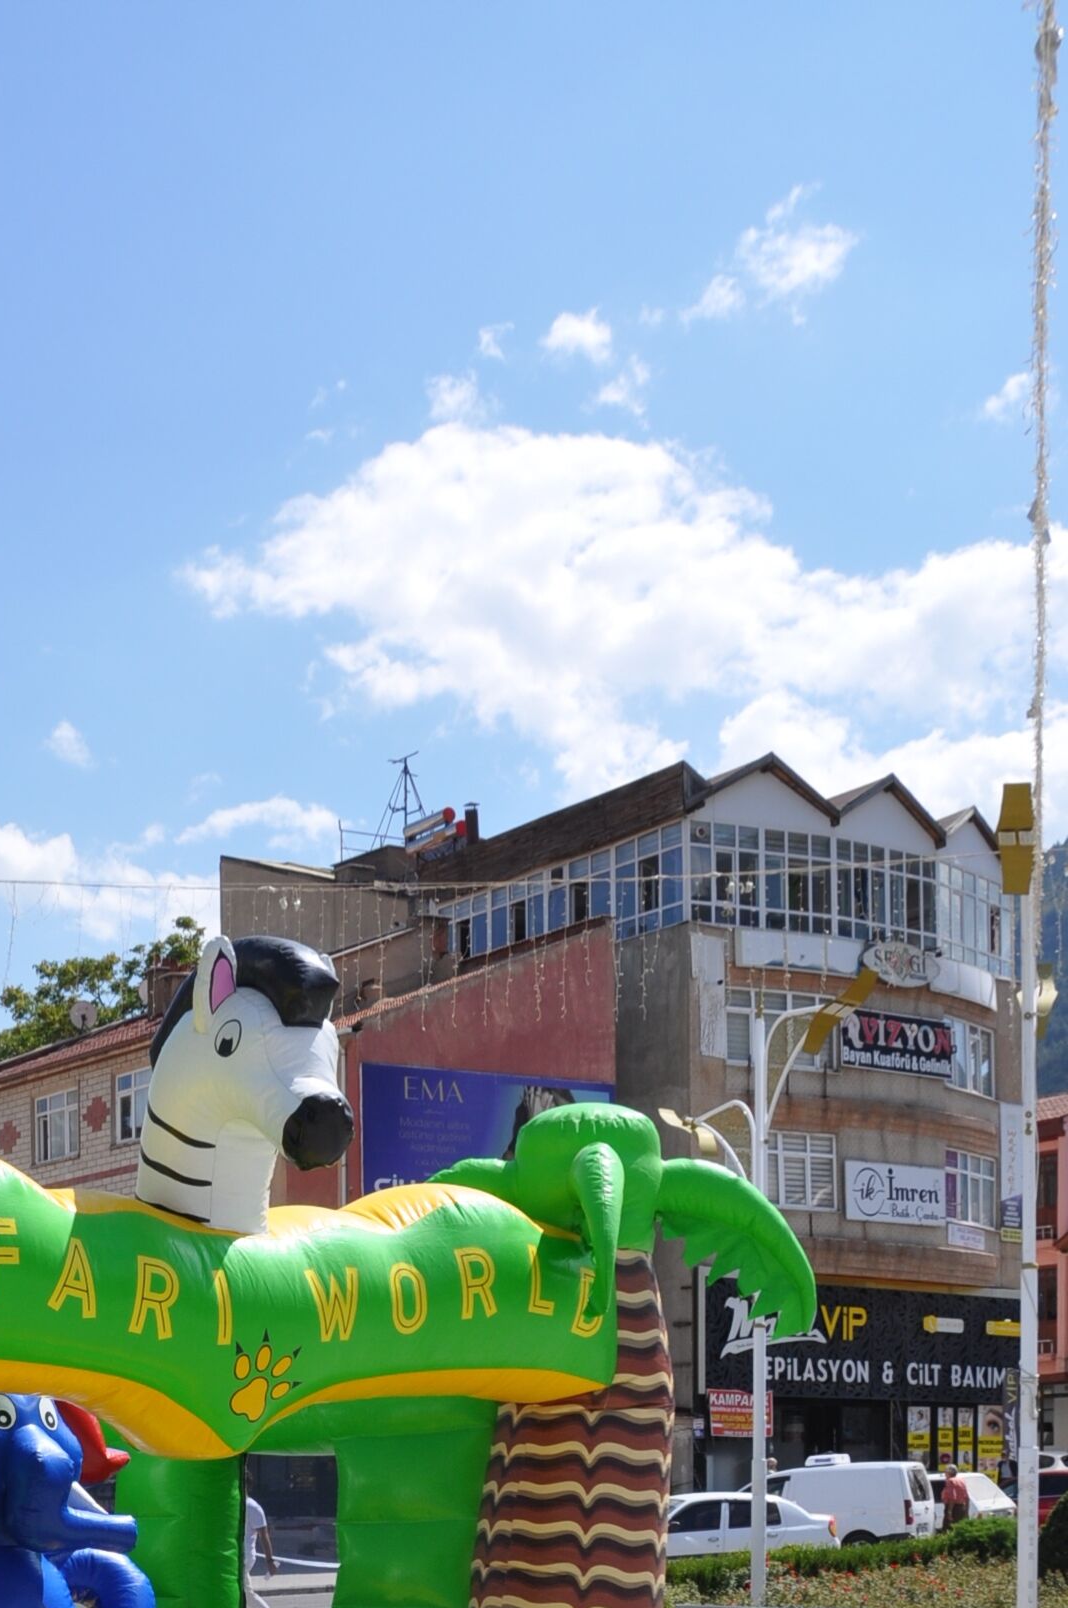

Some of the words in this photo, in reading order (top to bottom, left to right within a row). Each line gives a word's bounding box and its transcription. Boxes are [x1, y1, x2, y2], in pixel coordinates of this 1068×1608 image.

[843, 1046, 871, 1067] Bayan
[404, 1076, 464, 1103] EMA
[886, 1168, 940, 1204] İmren
[882, 1360, 894, 1385] &
[709, 1392, 770, 1408] KAMPA
